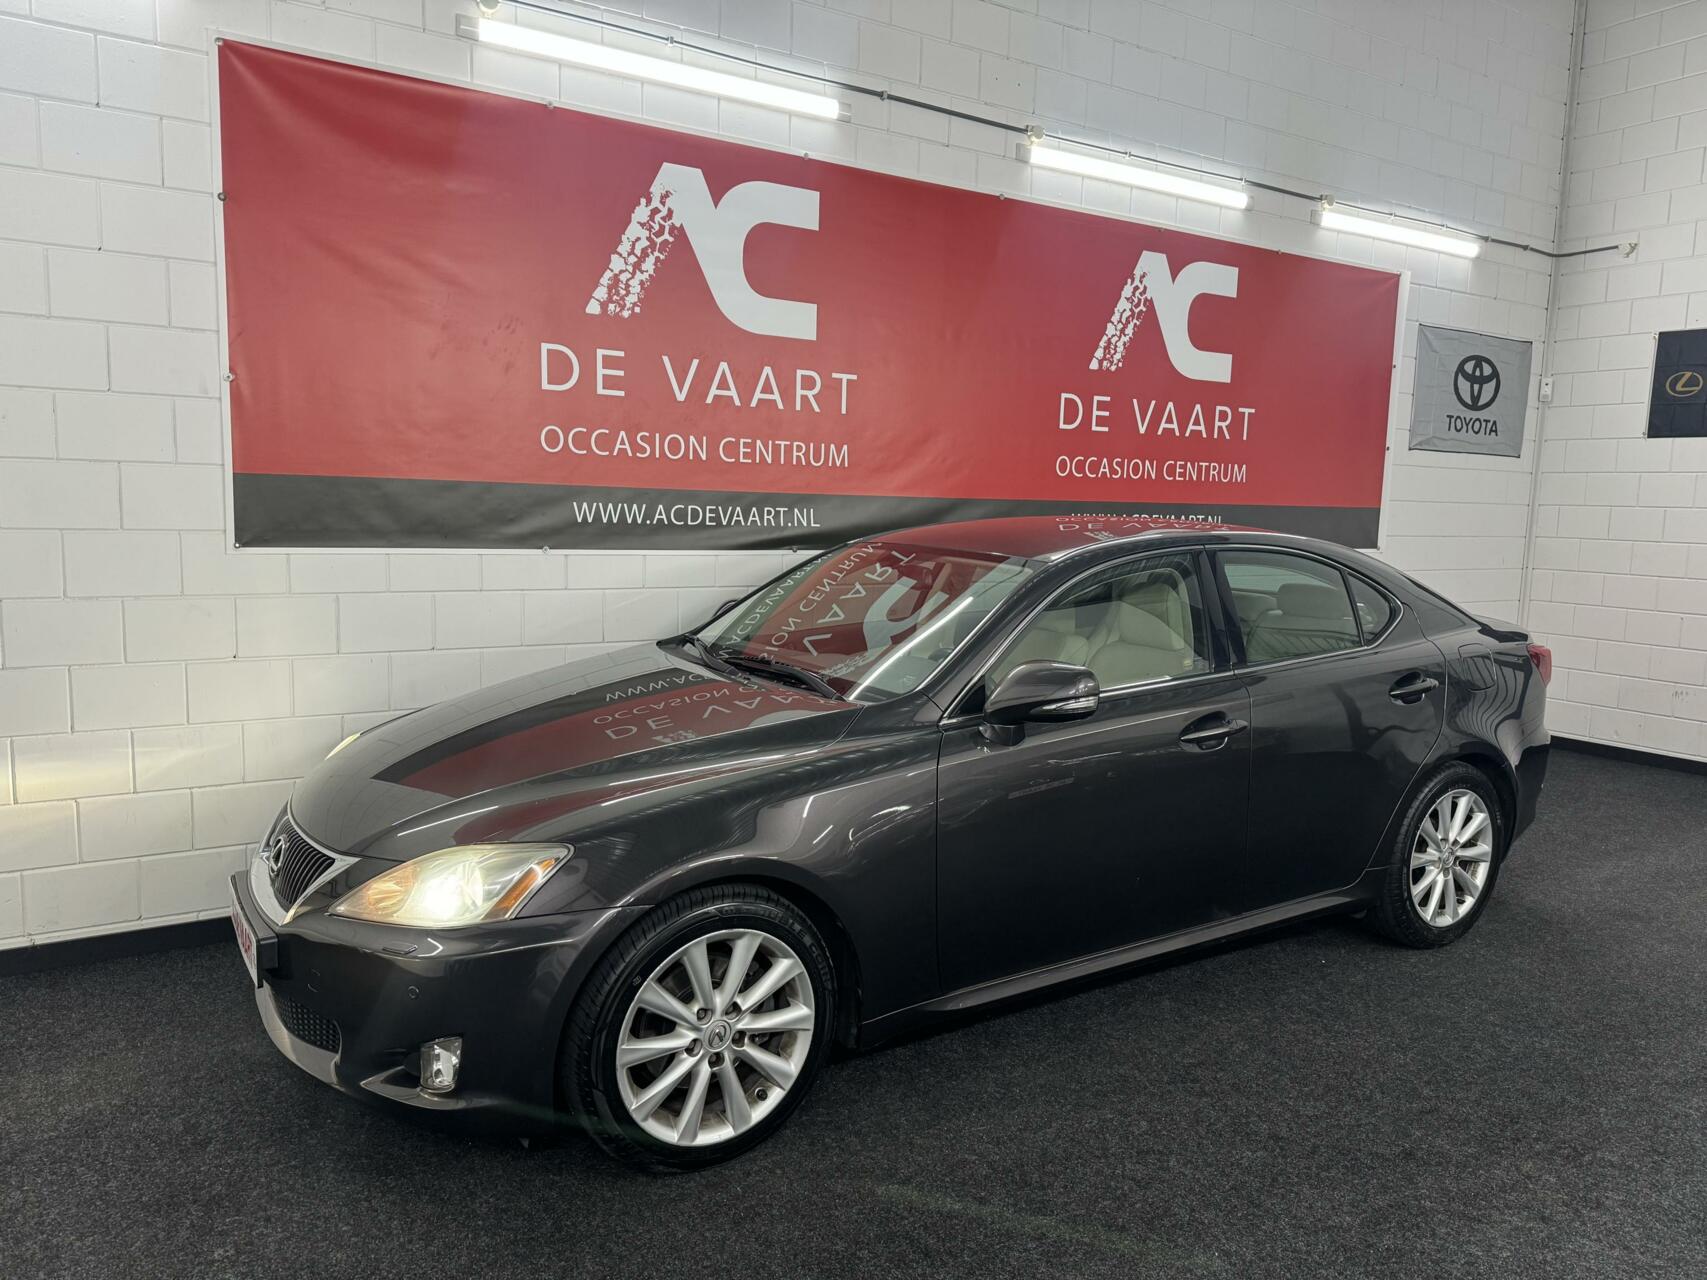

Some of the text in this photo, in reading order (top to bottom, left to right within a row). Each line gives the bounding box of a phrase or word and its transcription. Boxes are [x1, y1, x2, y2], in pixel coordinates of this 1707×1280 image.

[585, 161, 821, 341] AC
[1089, 250, 1239, 383] AC
[540, 341, 858, 415] DE VAART
[1058, 392, 1256, 441] DE VAART
[1446, 414, 1499, 437] TOYOTA
[540, 424, 849, 468] OCCASION CENTRUM
[1055, 455, 1248, 484] OCCASION CENTRUM
[573, 501, 821, 527] WWW.ACDEVAART.NL
